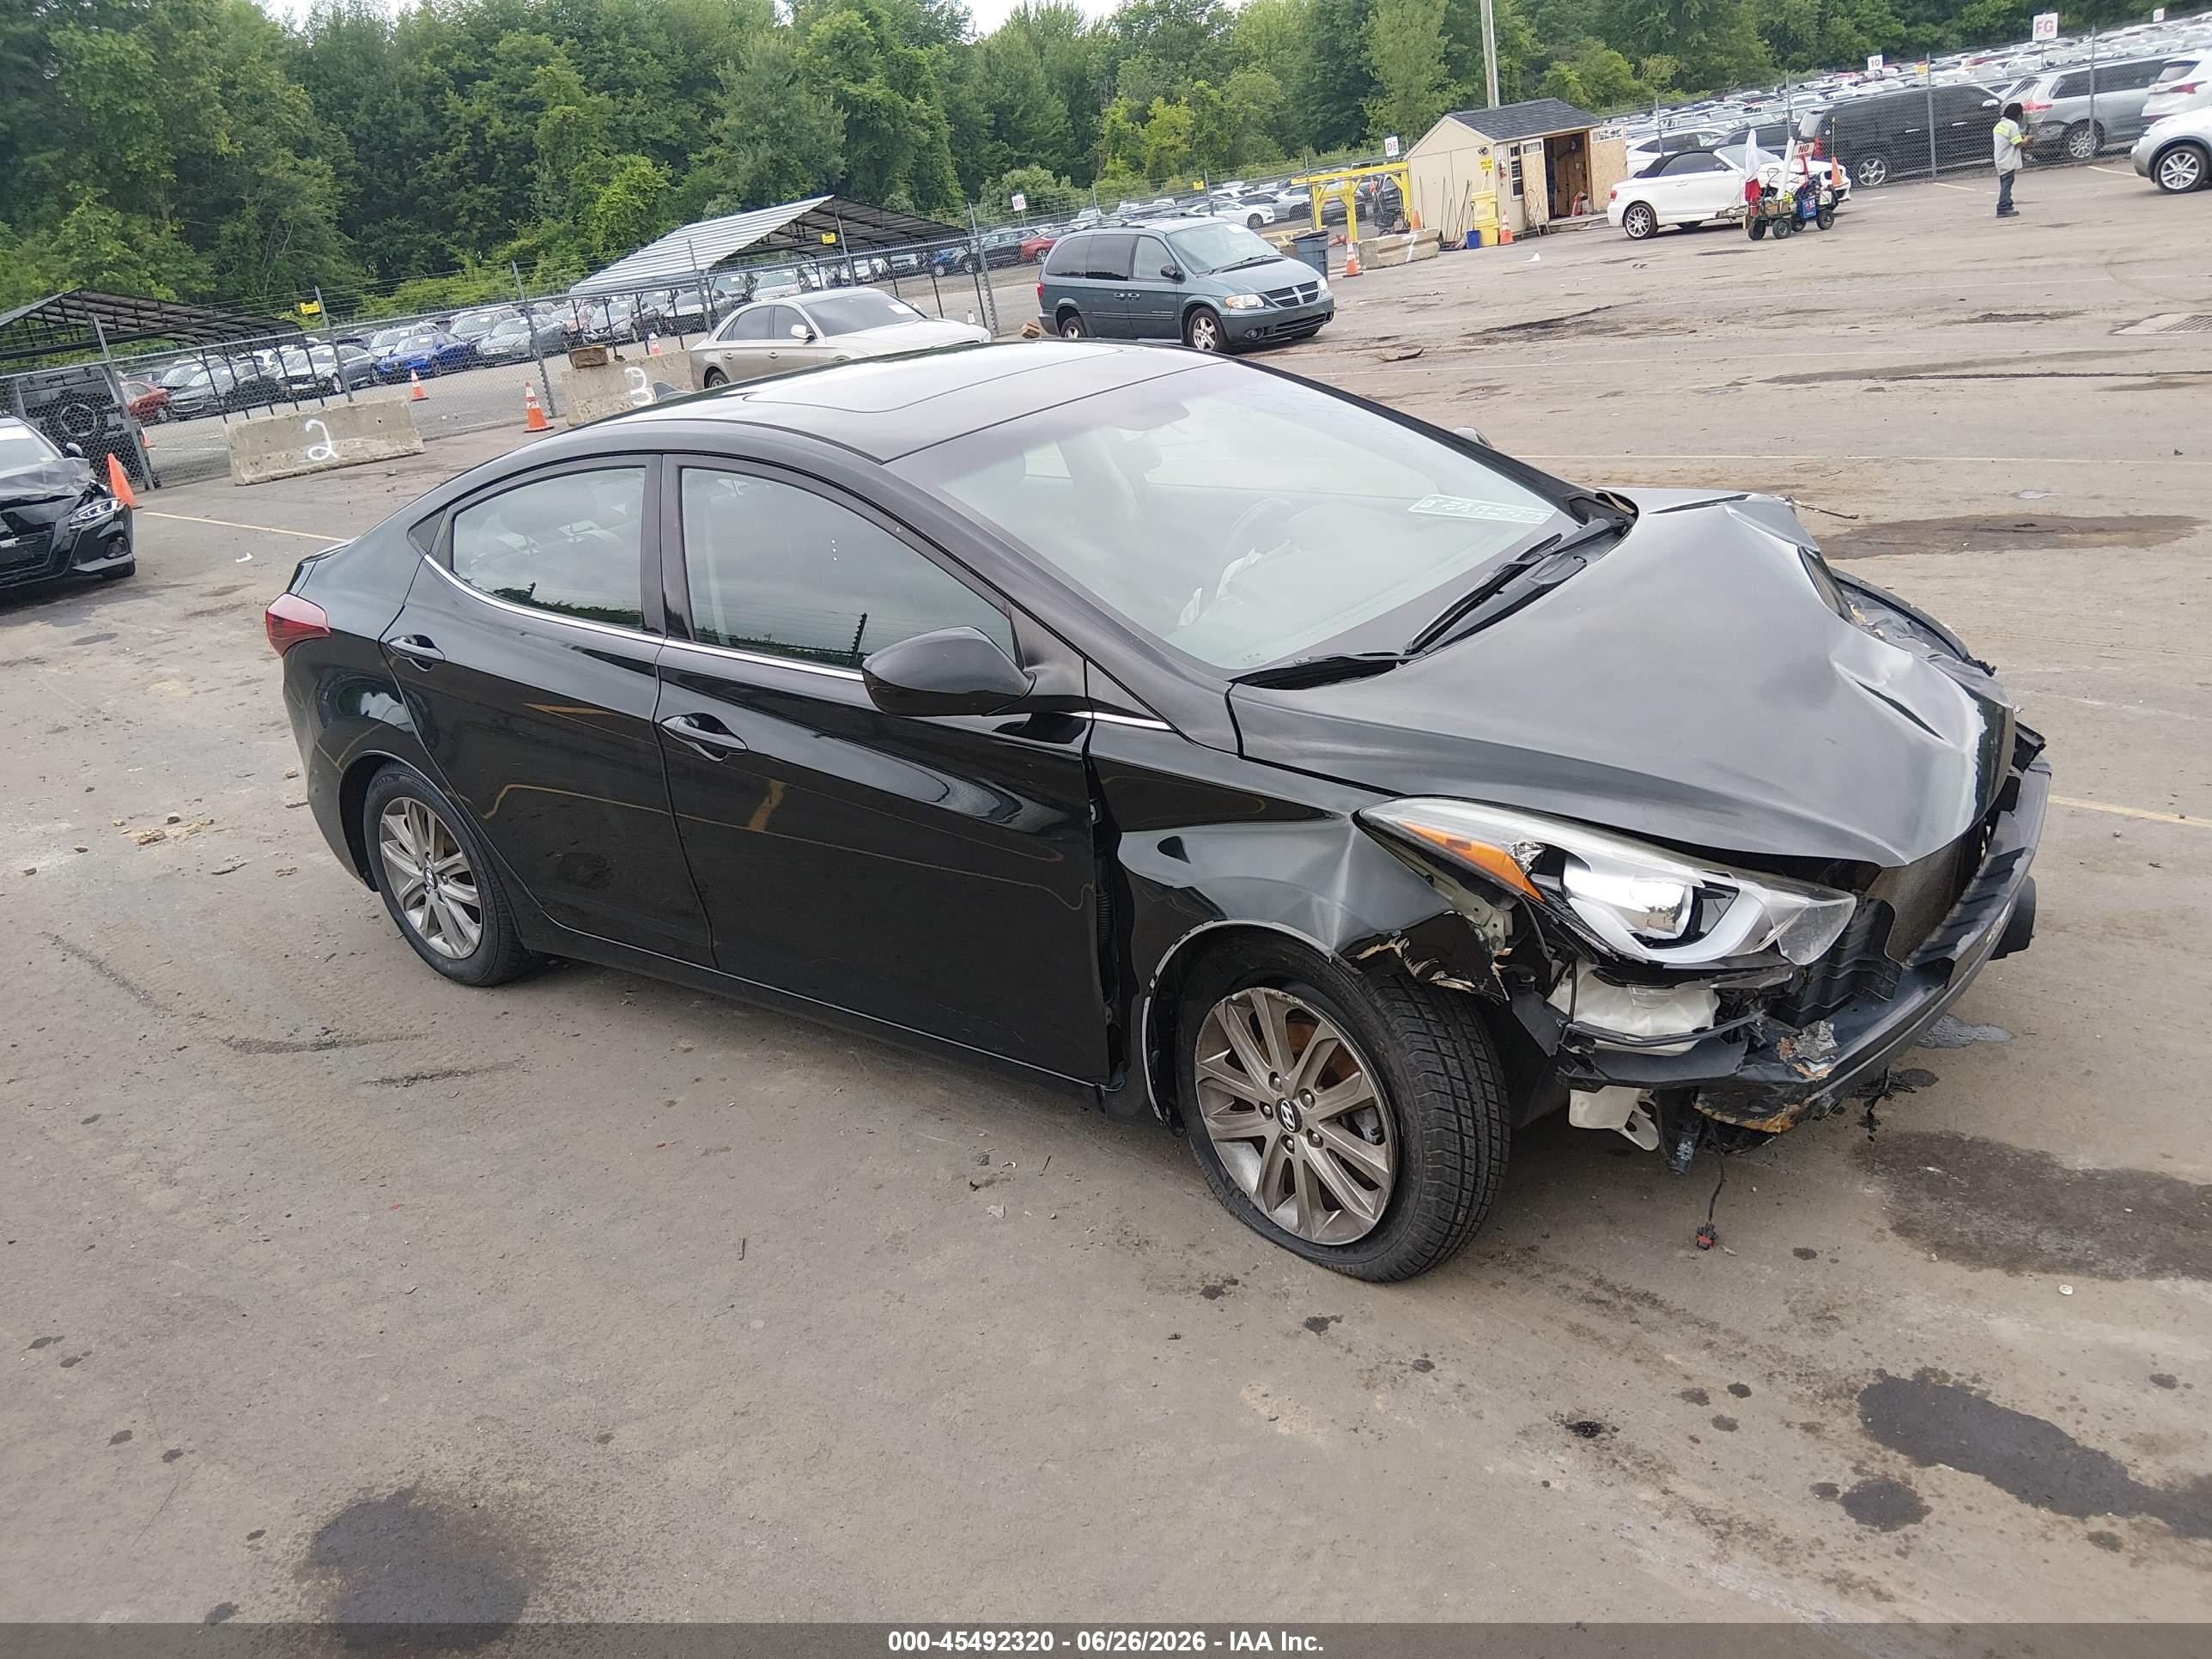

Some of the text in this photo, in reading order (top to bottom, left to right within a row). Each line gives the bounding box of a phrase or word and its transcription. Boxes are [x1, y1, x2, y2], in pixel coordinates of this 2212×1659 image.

[2035, 20, 2054, 34] FG
[1870, 58, 1881, 68] 10
[1387, 141, 1398, 152] DE
[1798, 143, 1810, 154] NO
[624, 366, 653, 407] 3
[305, 418, 338, 461] 2
